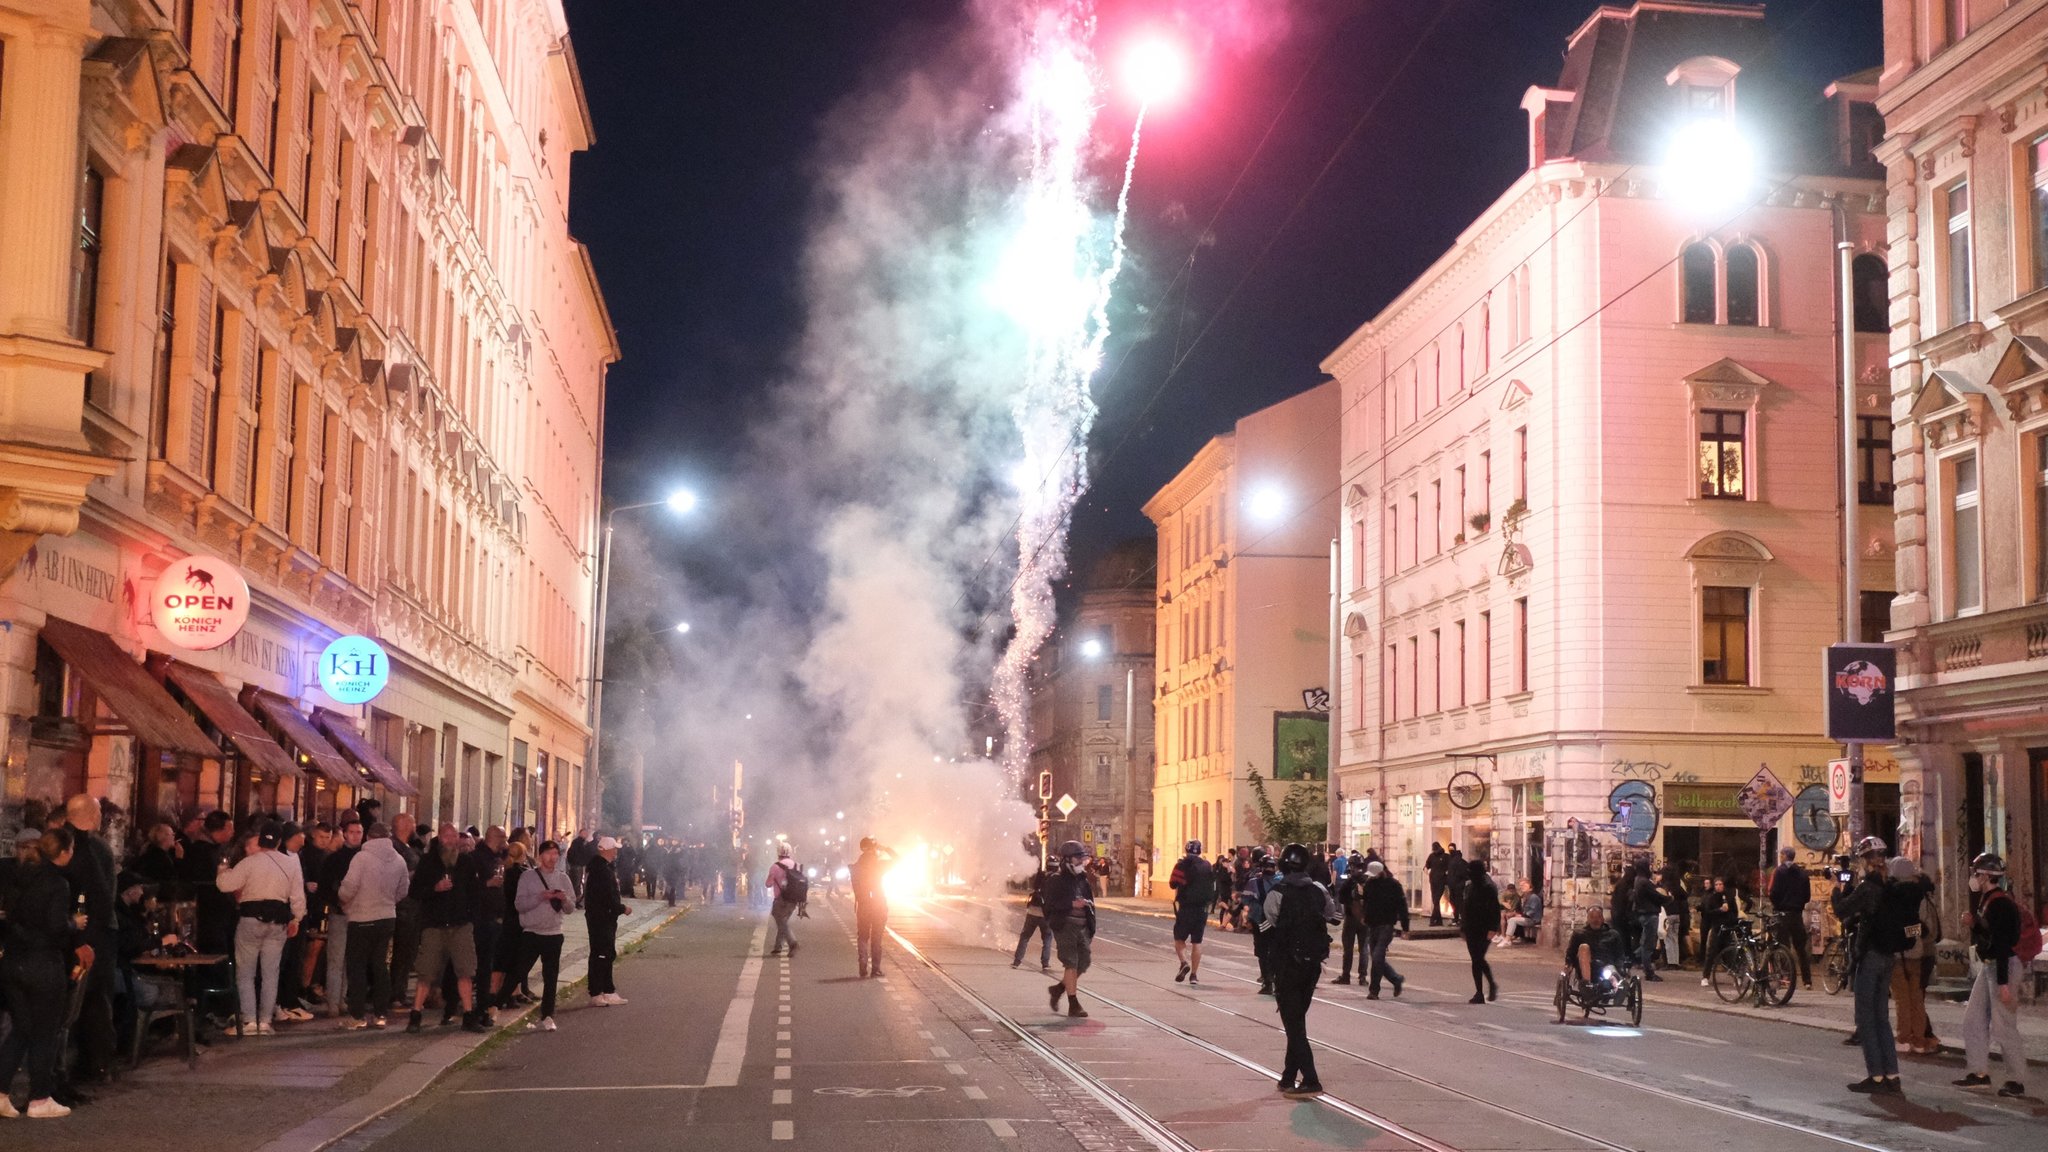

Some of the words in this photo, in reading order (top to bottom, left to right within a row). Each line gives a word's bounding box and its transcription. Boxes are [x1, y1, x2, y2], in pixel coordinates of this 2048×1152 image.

[85, 565, 116, 604] HEINZ
[164, 594, 234, 611] OPEN
[179, 625, 217, 633] HEINZ
[1835, 673, 1886, 691] KORN
[1834, 773, 1844, 791] 30
[1834, 801, 1846, 811] ZONE
